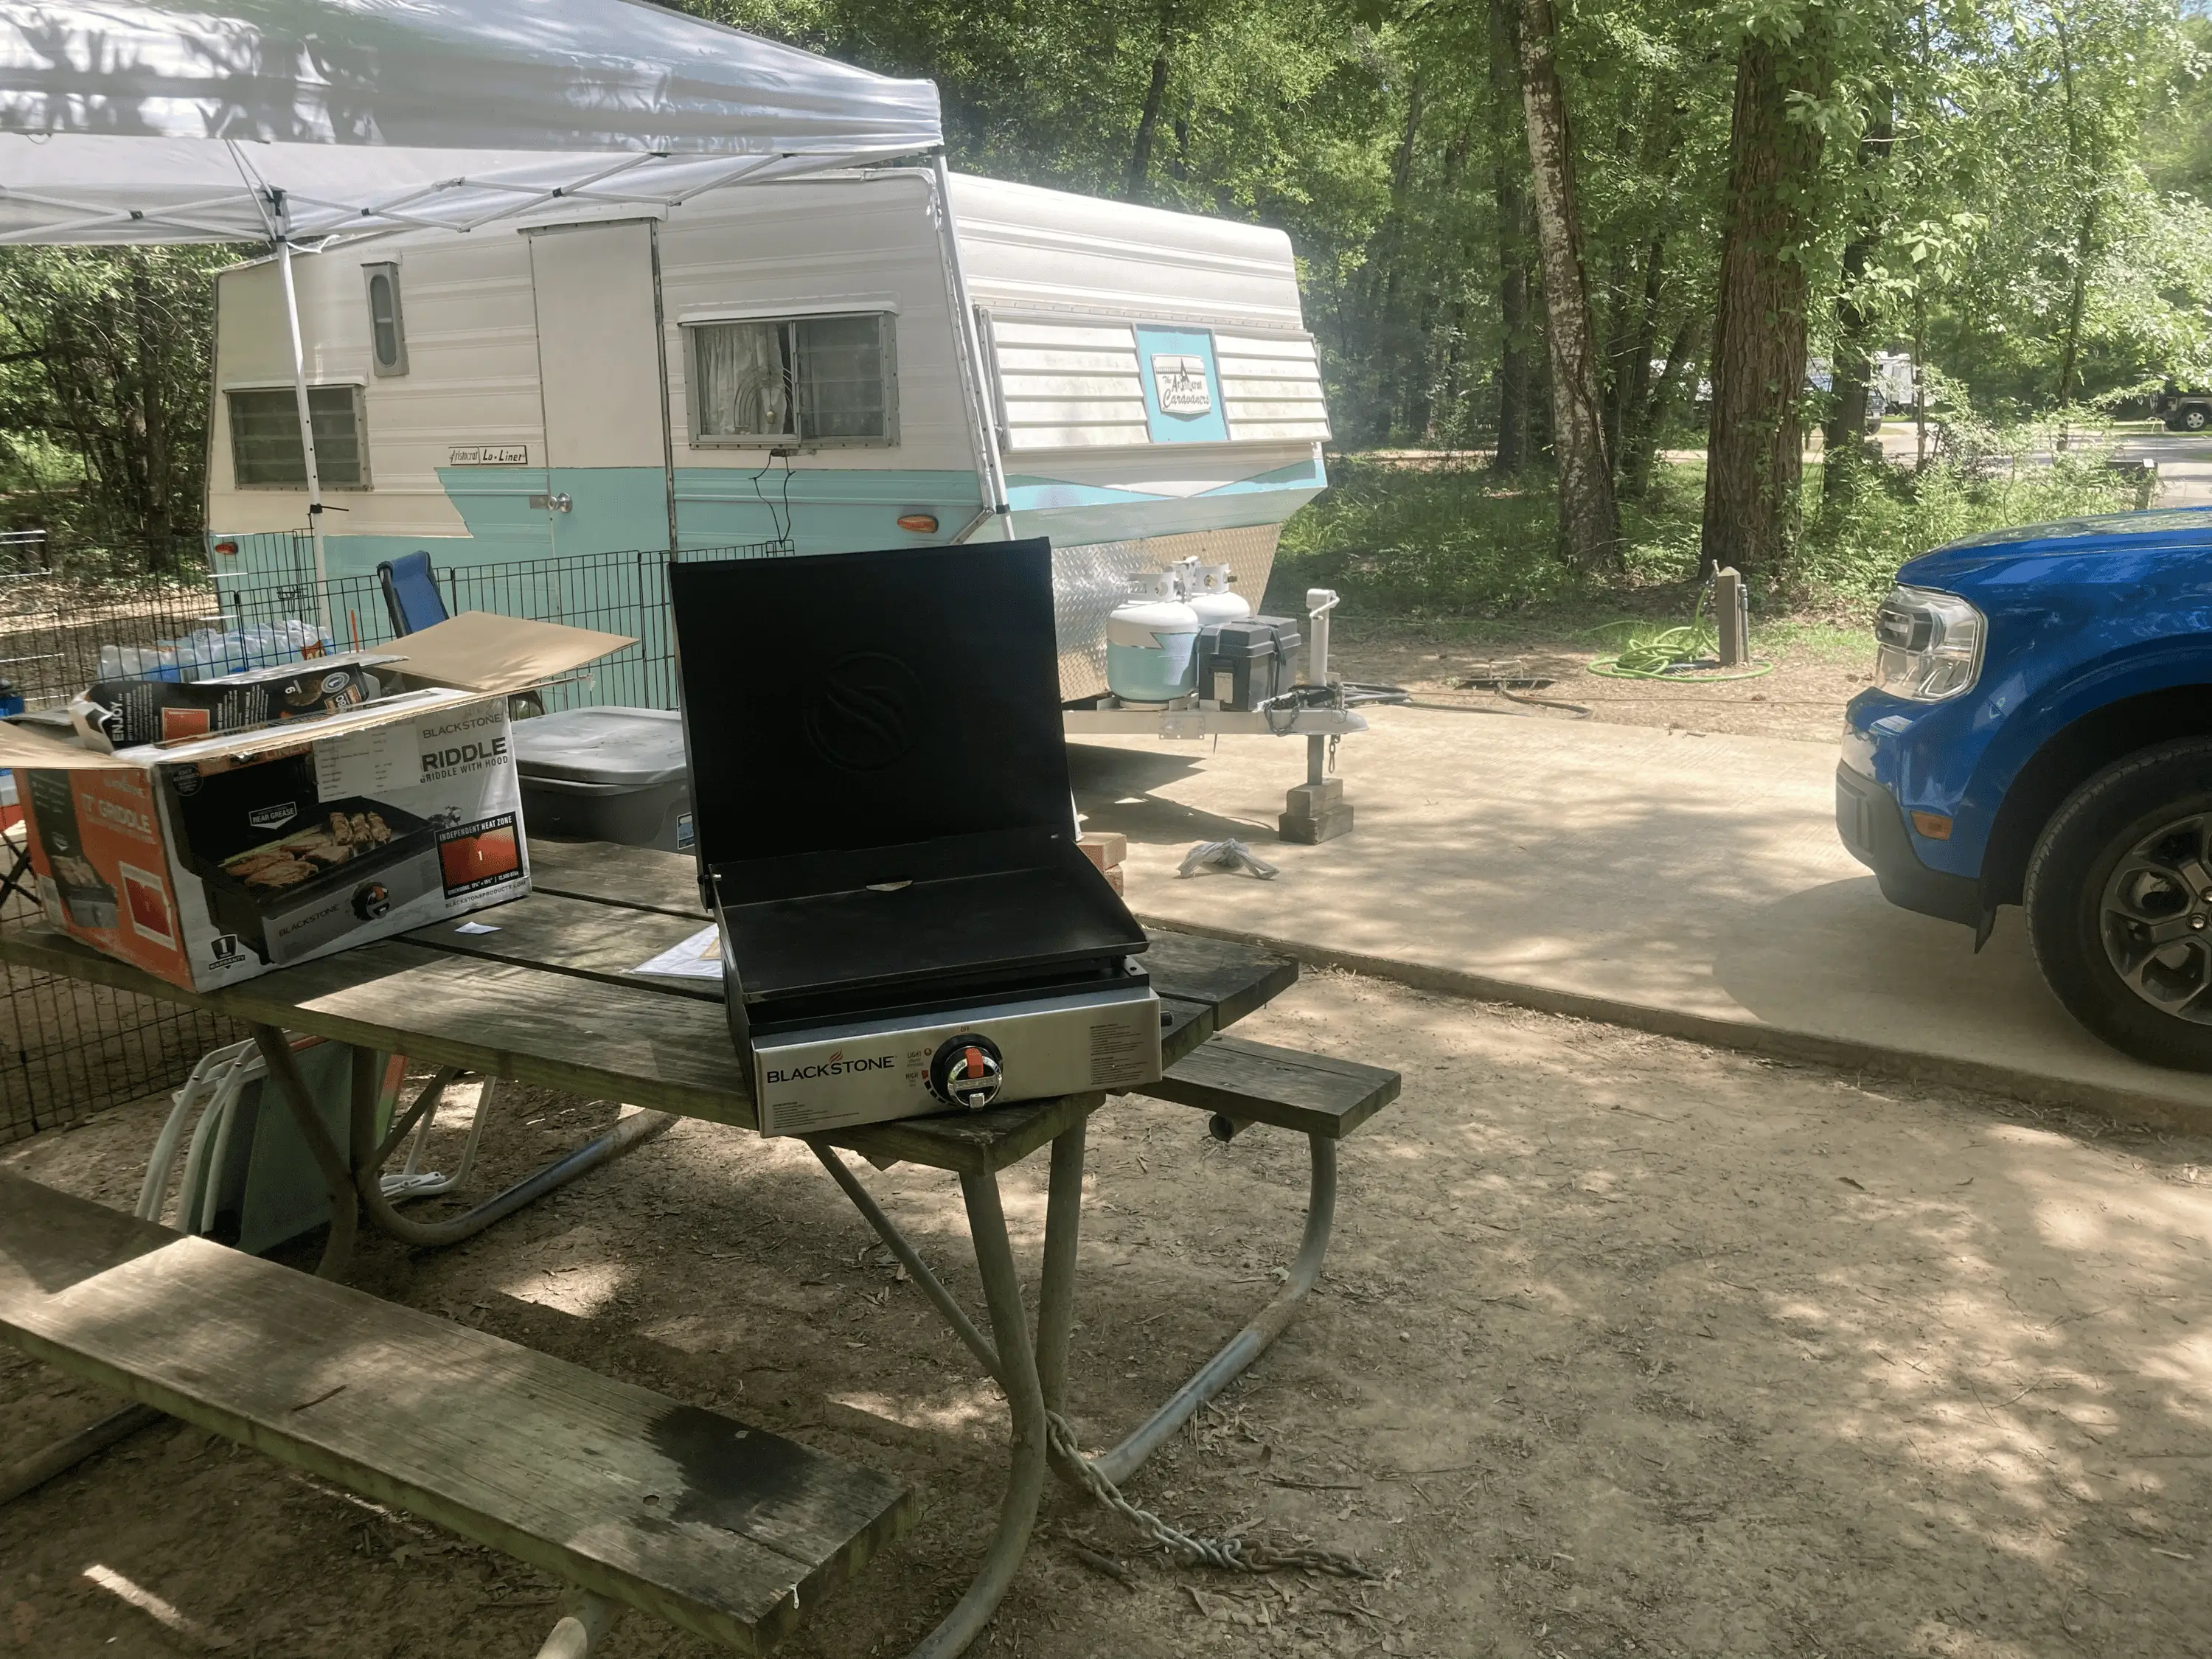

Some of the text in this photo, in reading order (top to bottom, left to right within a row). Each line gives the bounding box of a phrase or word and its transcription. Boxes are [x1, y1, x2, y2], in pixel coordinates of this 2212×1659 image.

[1164, 389, 1209, 408] Caravaners
[422, 714, 502, 739] BLACKSTONE
[460, 762, 482, 773] WITH
[485, 756, 508, 767] HOOD
[253, 812, 270, 824] REAR
[270, 808, 295, 820] GREASE
[439, 815, 512, 841] INDEPENDENT HEAT ZONE
[478, 850, 483, 861] 1
[279, 903, 341, 937] BLACKSTONE
[907, 1051, 922, 1059] LIGHT
[767, 1056, 894, 1083] BLACKSTONE
